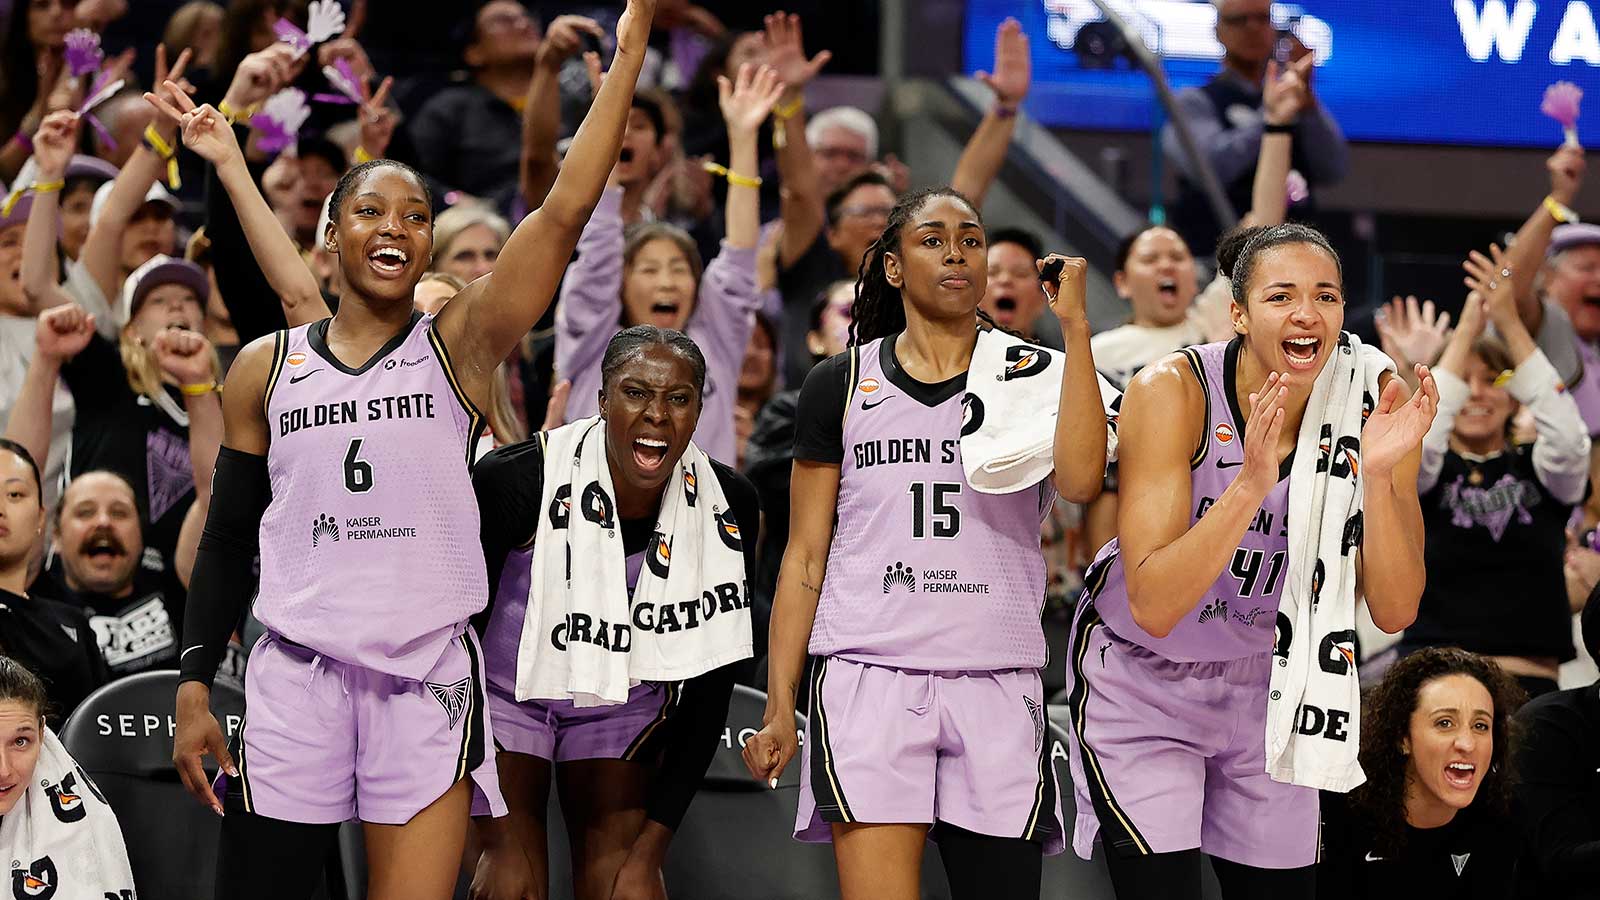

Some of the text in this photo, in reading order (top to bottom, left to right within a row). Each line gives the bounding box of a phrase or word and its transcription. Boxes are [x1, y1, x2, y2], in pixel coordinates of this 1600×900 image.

[400, 355, 430, 368] freedom
[279, 393, 436, 438] GOLDEN STATE
[853, 439, 931, 469] GOLDEN
[342, 436, 375, 495] 6
[907, 481, 962, 540] 15
[346, 516, 381, 528] KAISER
[347, 527, 417, 540] PERMANENTE
[923, 570, 958, 580] KAISER
[1229, 546, 1287, 599] 41
[923, 583, 990, 594] PERMANENTE
